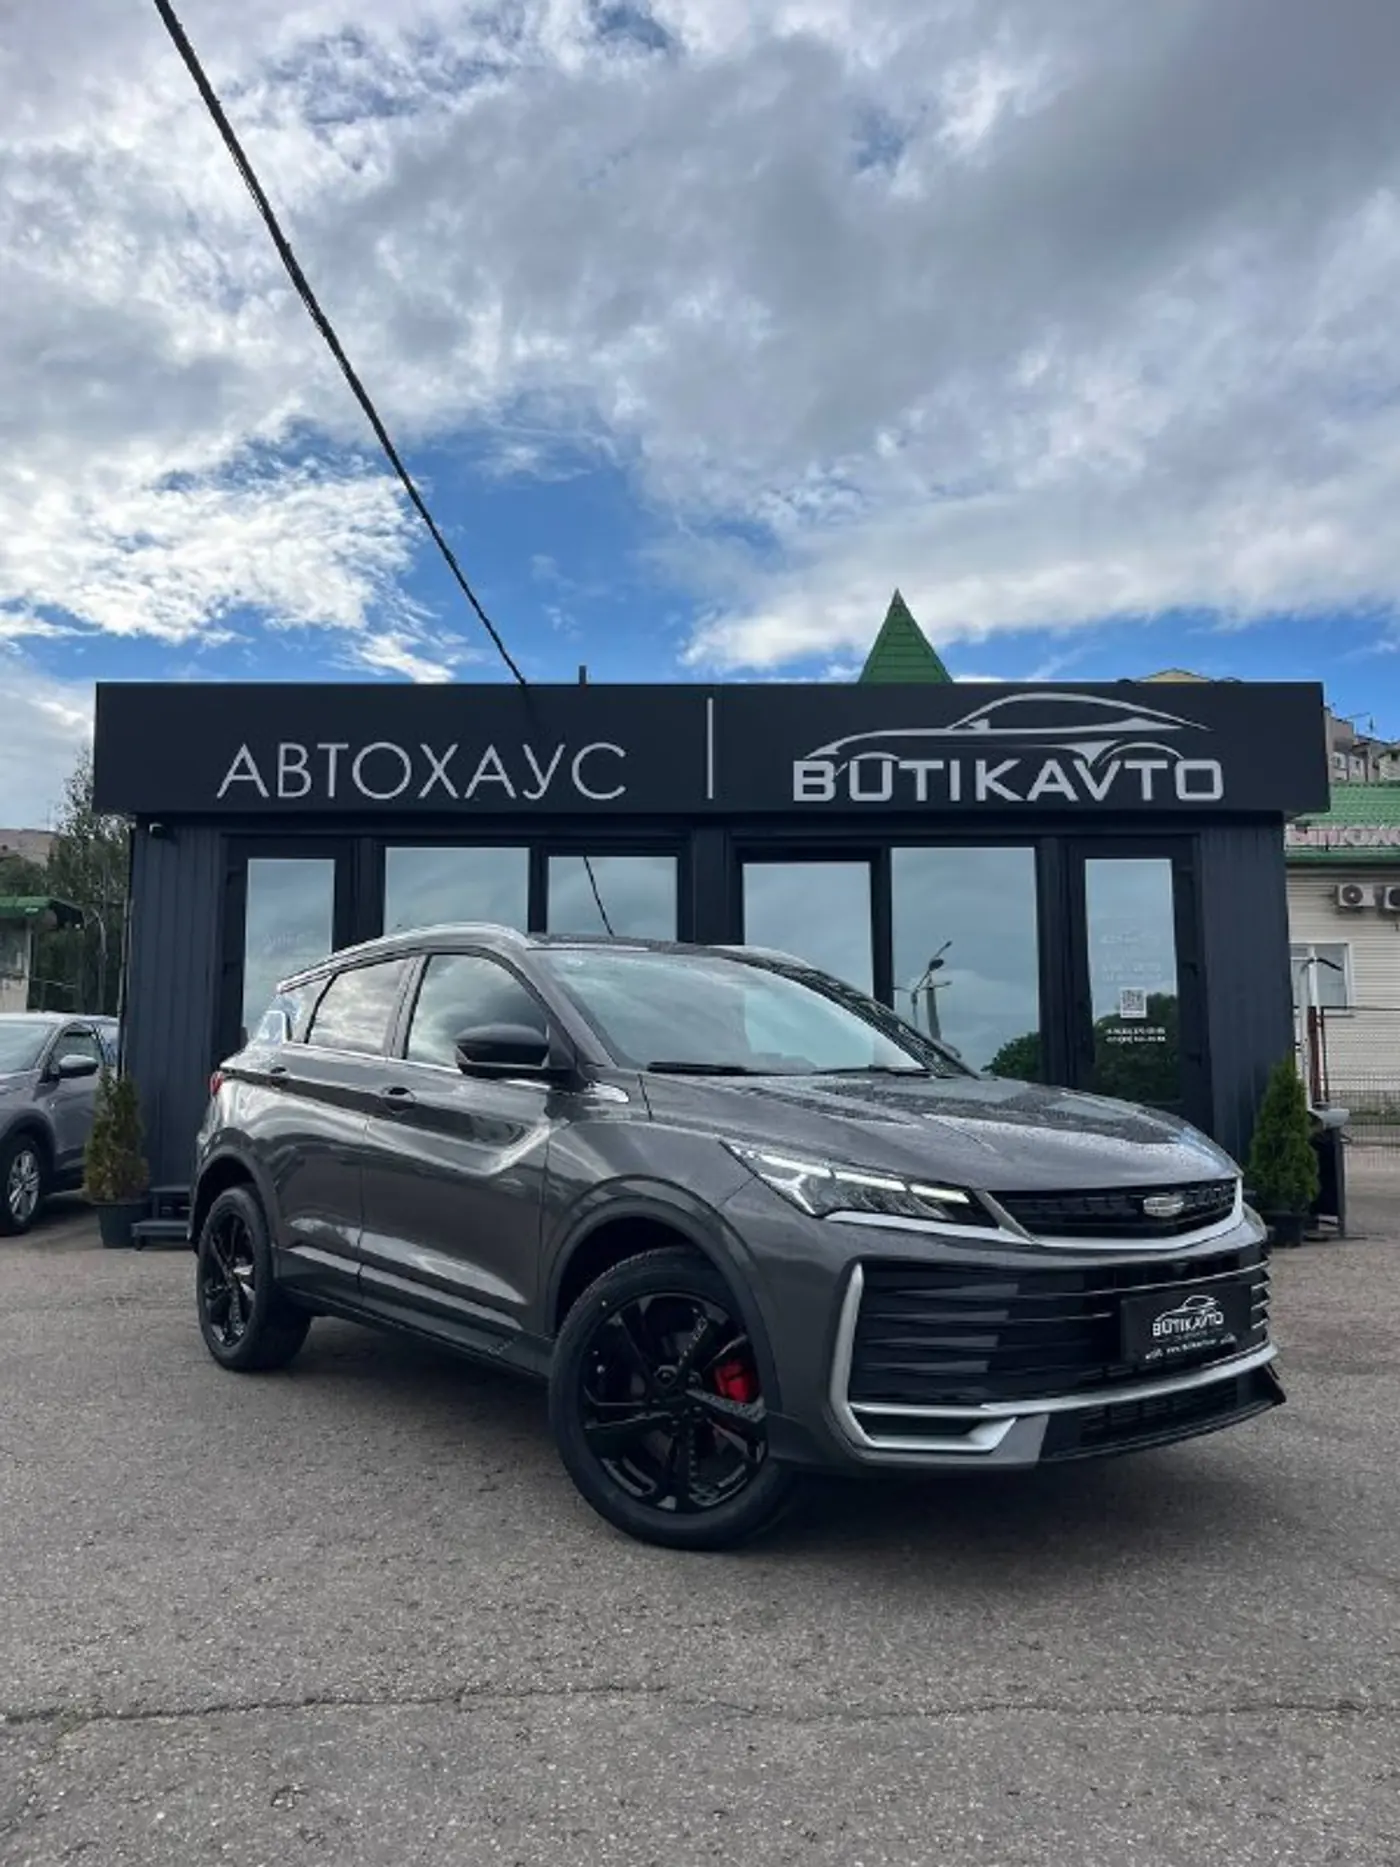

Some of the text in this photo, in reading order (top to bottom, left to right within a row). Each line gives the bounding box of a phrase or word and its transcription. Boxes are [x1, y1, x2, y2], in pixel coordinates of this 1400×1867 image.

[216, 742, 626, 800] АВТОХАУС
[793, 758, 1224, 801] BUTIKAVTO
[1152, 1311, 1224, 1336] BUTIKAVTO
